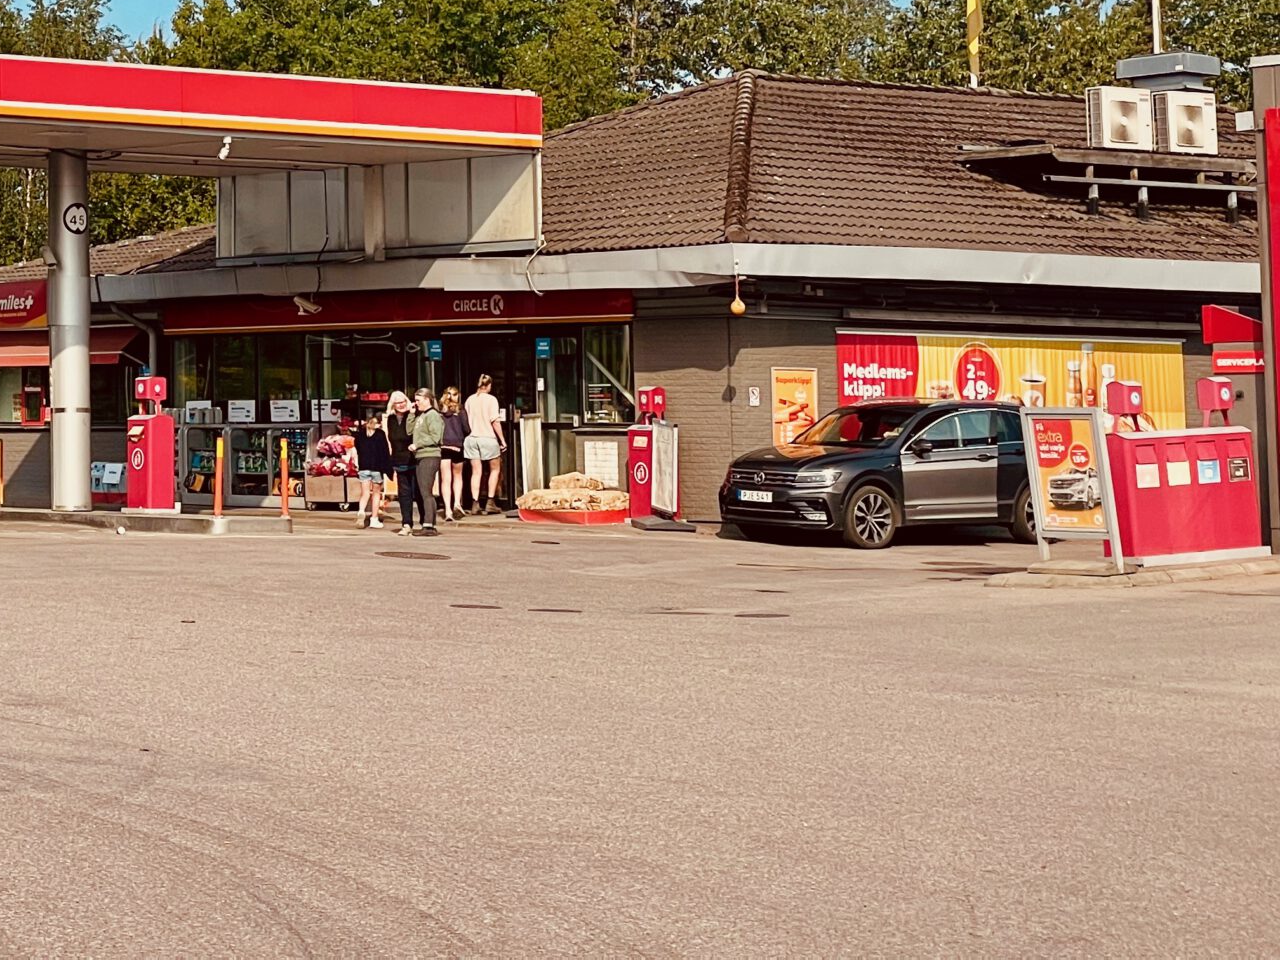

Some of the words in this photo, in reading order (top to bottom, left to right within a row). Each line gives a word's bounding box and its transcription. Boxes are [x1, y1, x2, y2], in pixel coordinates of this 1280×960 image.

[70, 214, 85, 226] 45
[453, 299, 488, 312] CIRCLE
[843, 362, 914, 380] Medlems-
[966, 363, 976, 379] 2
[843, 380, 886, 400] klipp!
[1037, 430, 1063, 443] extra
